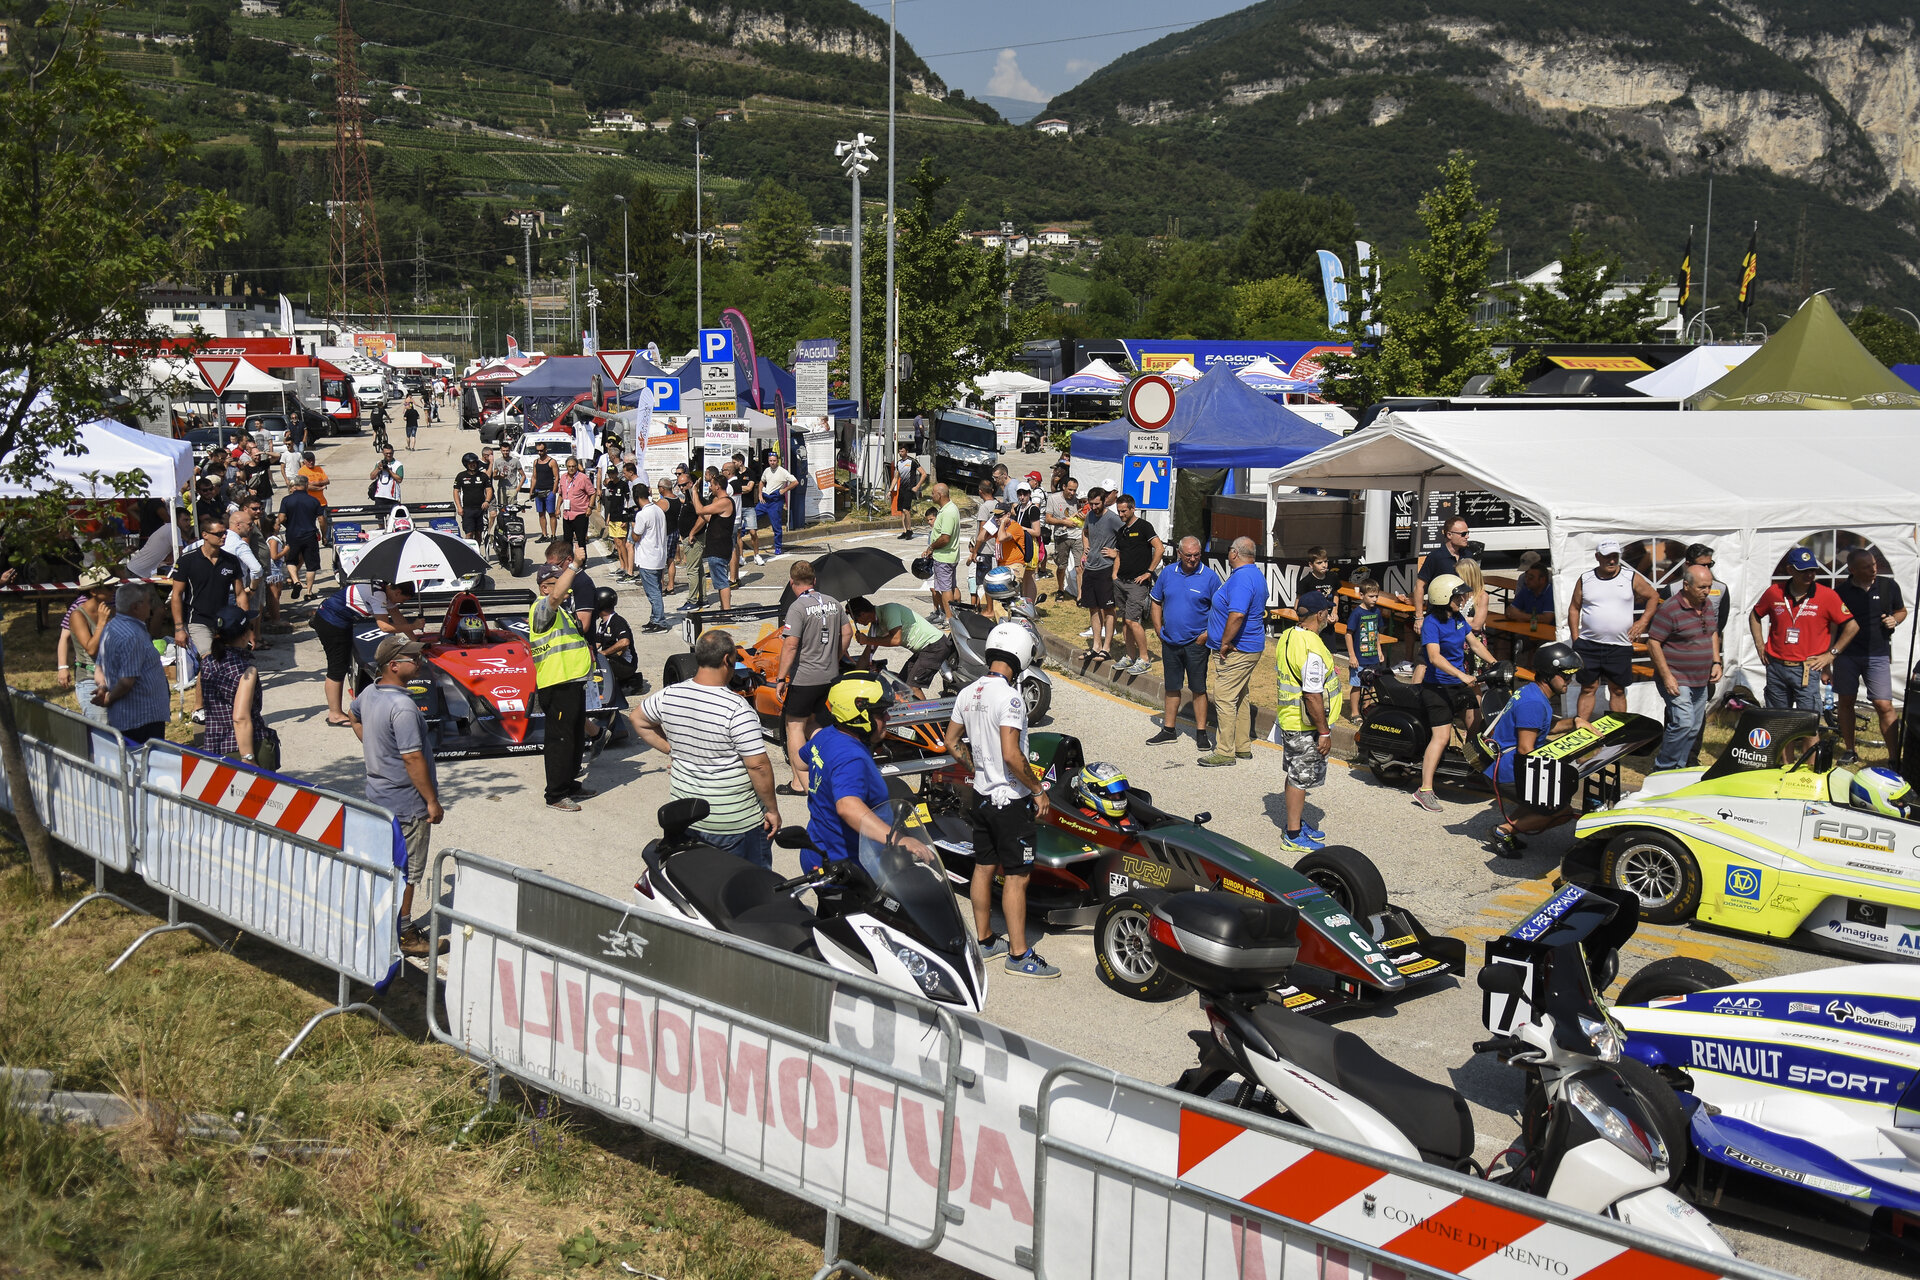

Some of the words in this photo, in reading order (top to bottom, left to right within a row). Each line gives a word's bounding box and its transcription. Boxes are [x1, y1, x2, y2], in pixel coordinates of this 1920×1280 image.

[706, 333, 726, 359] P
[799, 347, 836, 359] FAGGIOLI
[1146, 357, 1189, 368] PIRE
[1560, 359, 1641, 369] PIRELLI
[653, 382, 673, 407] P
[1741, 391, 1811, 406] FORST
[507, 700, 516, 711] 5
[1753, 730, 1767, 746] M
[1731, 747, 1768, 762] Officina
[1738, 758, 1767, 768] Montagna
[1733, 815, 1768, 826] POWERSHIFT
[1813, 819, 1896, 851] FDR
[1822, 836, 1887, 852] AUTOMAZIONI
[1122, 855, 1171, 884] TURN
[1223, 877, 1245, 892] EUROPA
[1245, 885, 1265, 901] DIESEL
[1723, 901, 1760, 912] DONATONI
[1518, 923, 1539, 942] ACK
[1842, 925, 1889, 942] magigas
[1348, 931, 1373, 953] 6
[1386, 935, 1412, 947] BARDAHL
[1399, 960, 1435, 973] PIRELLI
[1715, 997, 1762, 1009] MAD
[1713, 1007, 1763, 1018] HOTEL
[1855, 1014, 1916, 1033] POWERSHIFT
[1691, 1040, 1783, 1079] RENAULT
[1788, 1065, 1890, 1094] SPORT
[1729, 1149, 1802, 1181] ZUCCARI
[1383, 1205, 1463, 1244] COMUNE
[1468, 1232, 1487, 1251] DI
[1491, 1238, 1569, 1276] TRENTO
